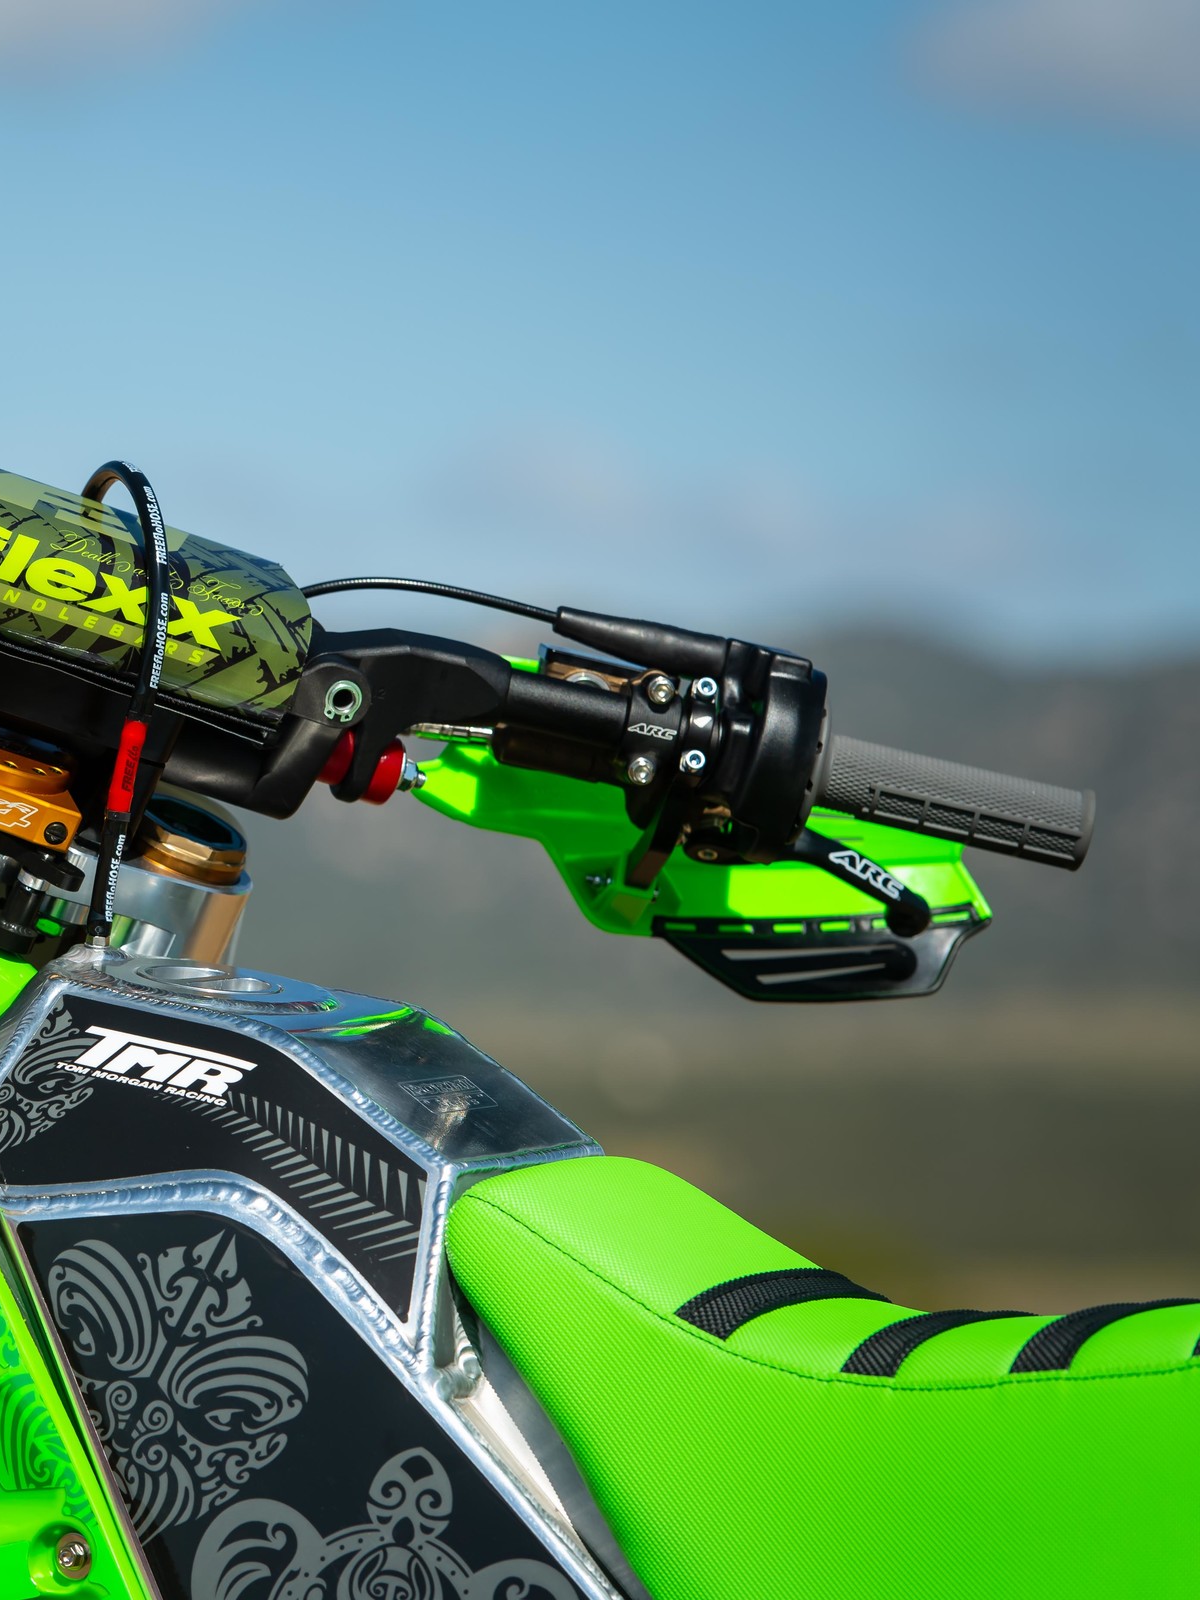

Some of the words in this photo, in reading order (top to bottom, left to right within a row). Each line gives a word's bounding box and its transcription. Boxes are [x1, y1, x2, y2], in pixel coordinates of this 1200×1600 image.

[50, 530, 131, 573] Death
[627, 723, 678, 741] ARC
[828, 850, 904, 900] ARC
[74, 1025, 258, 1097] TMR
[56, 1062, 89, 1075] TOM
[91, 1070, 164, 1091] MORGAN
[163, 1087, 228, 1107] RACING
